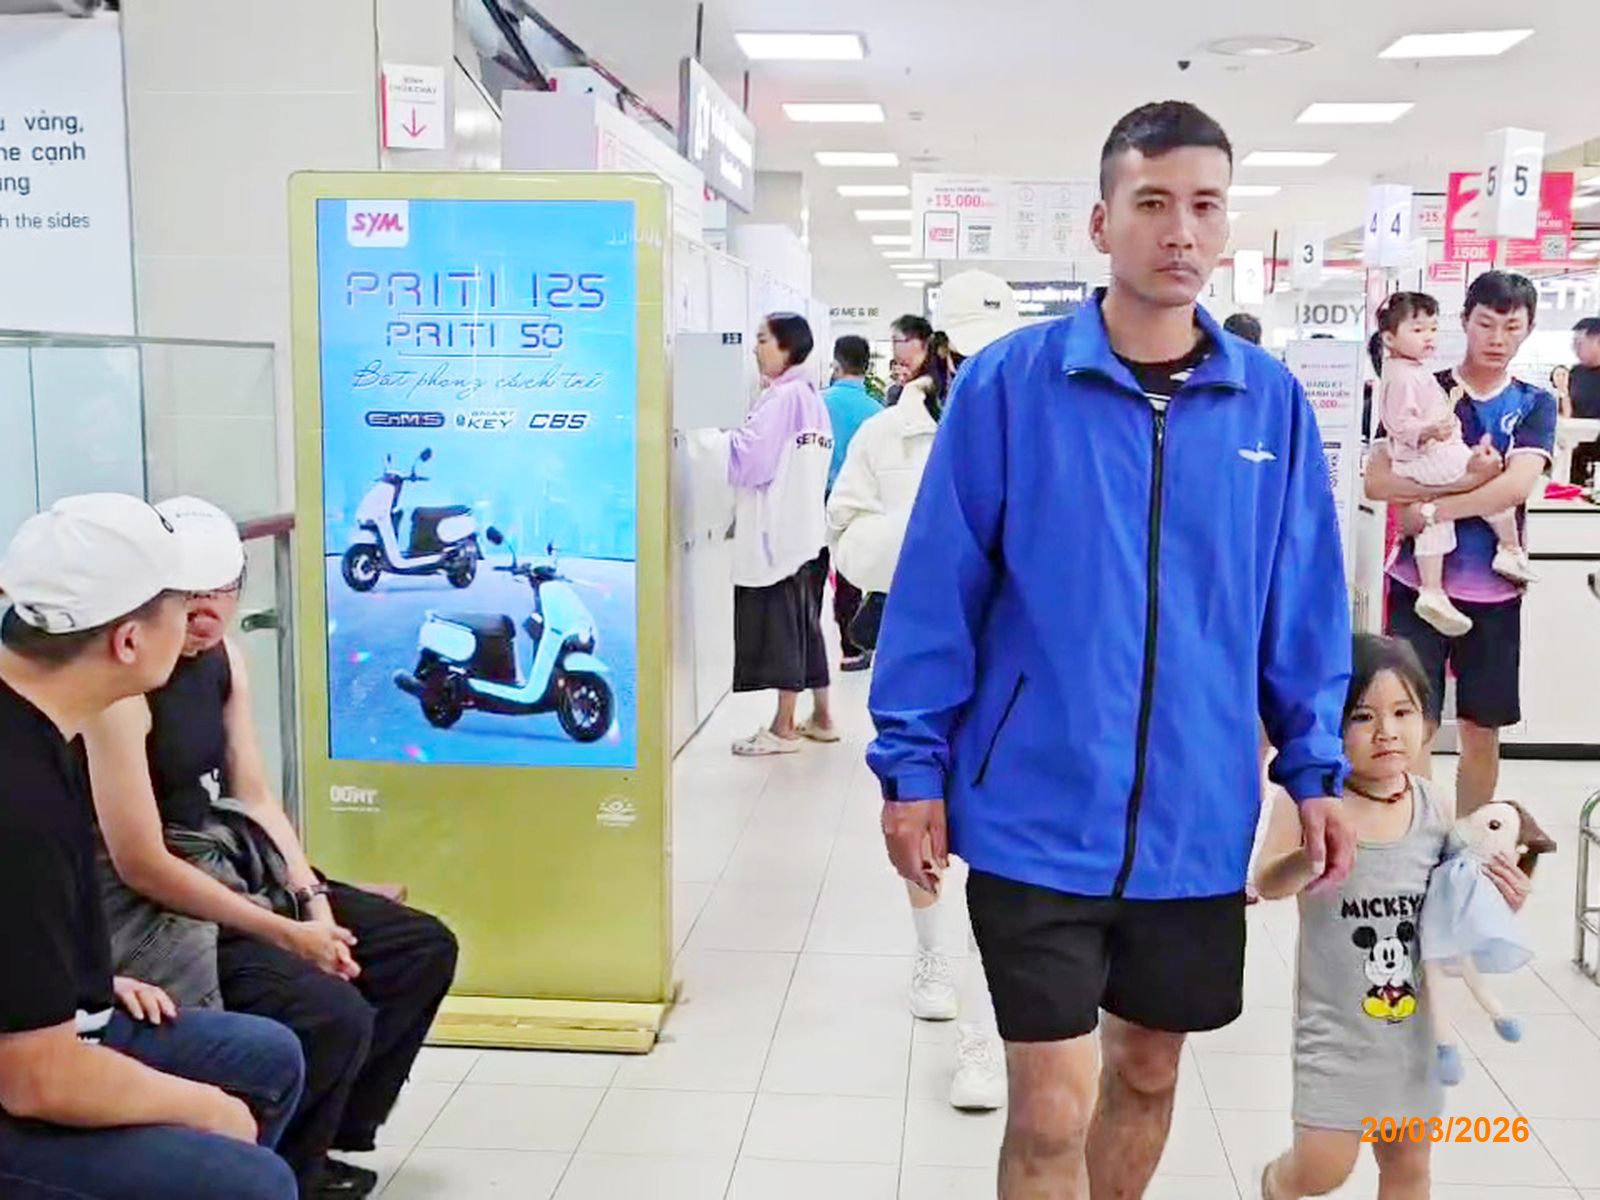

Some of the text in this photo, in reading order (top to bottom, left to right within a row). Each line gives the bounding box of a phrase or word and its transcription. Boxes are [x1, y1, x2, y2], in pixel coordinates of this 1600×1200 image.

[32, 141, 86, 165] cạnh
[0, 175, 30, 195] ng
[1486, 165, 1497, 197] 5
[1514, 165, 1528, 197] 5
[15, 213, 42, 228] the
[47, 212, 91, 228] sides
[352, 212, 404, 237] SYM
[1369, 212, 1378, 233] 4
[1390, 212, 1401, 236] 4
[1303, 244, 1314, 263] 3
[347, 271, 605, 308] PRITI 125
[386, 322, 563, 349] PRITI 50
[467, 413, 588, 430] KEY CBS
[1340, 895, 1423, 920] MICKEY
